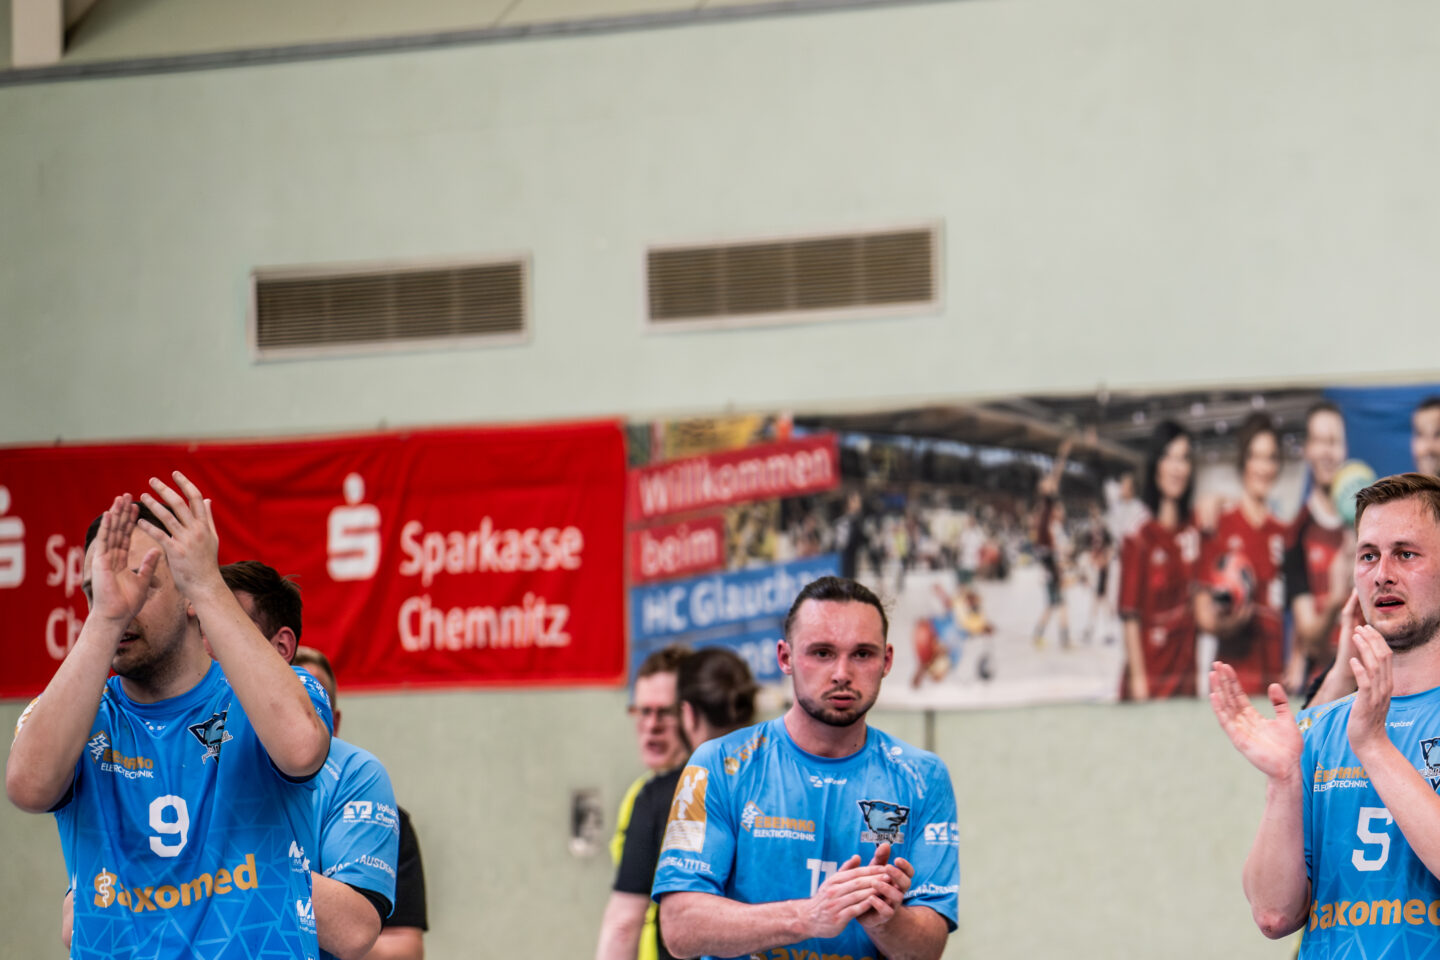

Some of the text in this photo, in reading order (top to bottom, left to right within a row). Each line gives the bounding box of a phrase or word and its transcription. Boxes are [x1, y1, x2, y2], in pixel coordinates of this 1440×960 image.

[640, 447, 832, 516] Willkommen
[400, 521, 585, 584] Sparkasse
[640, 525, 719, 576] beim
[399, 598, 570, 654] Chemnitz
[642, 569, 837, 634] HC Glauch
[149, 794, 190, 858] 9
[1351, 807, 1393, 872] 5
[94, 854, 258, 912] Saxomed
